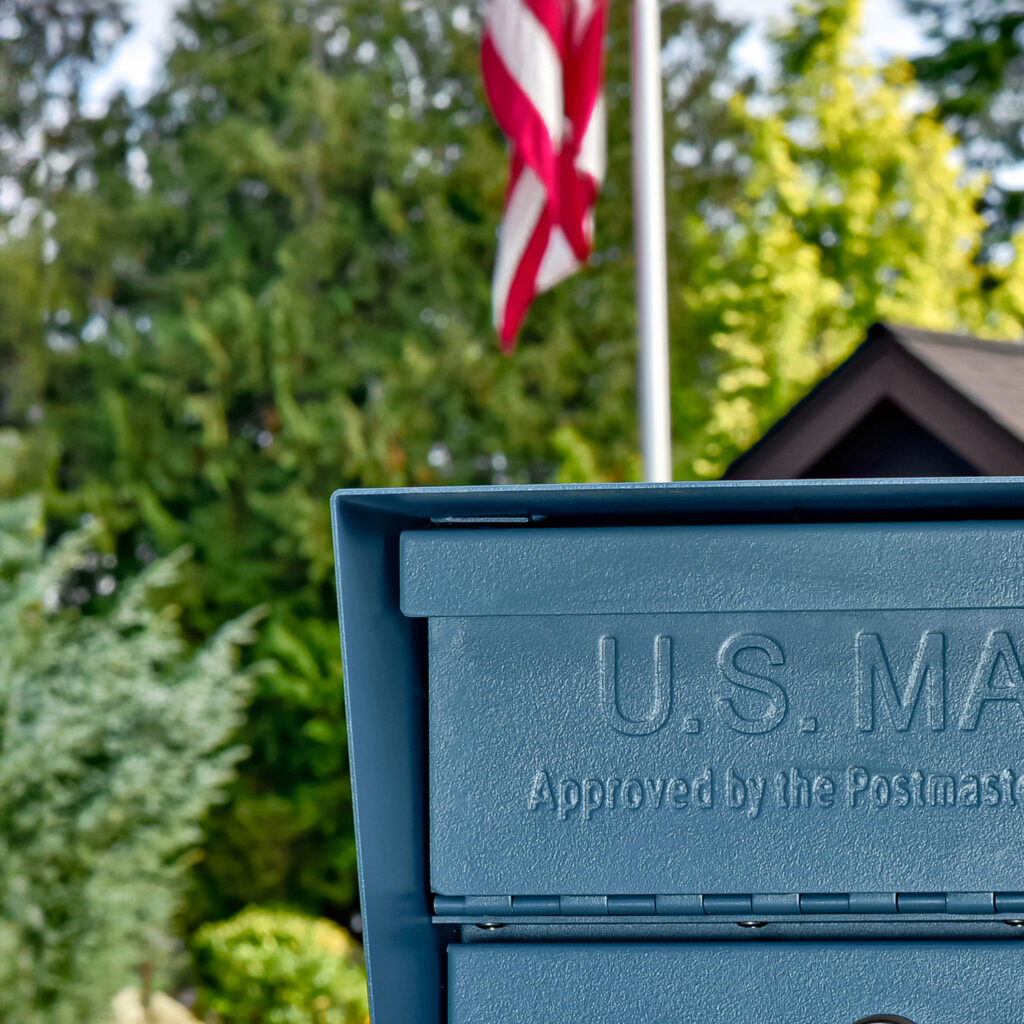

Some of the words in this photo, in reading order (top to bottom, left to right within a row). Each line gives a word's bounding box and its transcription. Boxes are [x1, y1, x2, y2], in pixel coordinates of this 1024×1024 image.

[597, 632, 819, 737] U.S.
[528, 769, 713, 820] Approved
[725, 767, 764, 819] by
[771, 767, 834, 809] the
